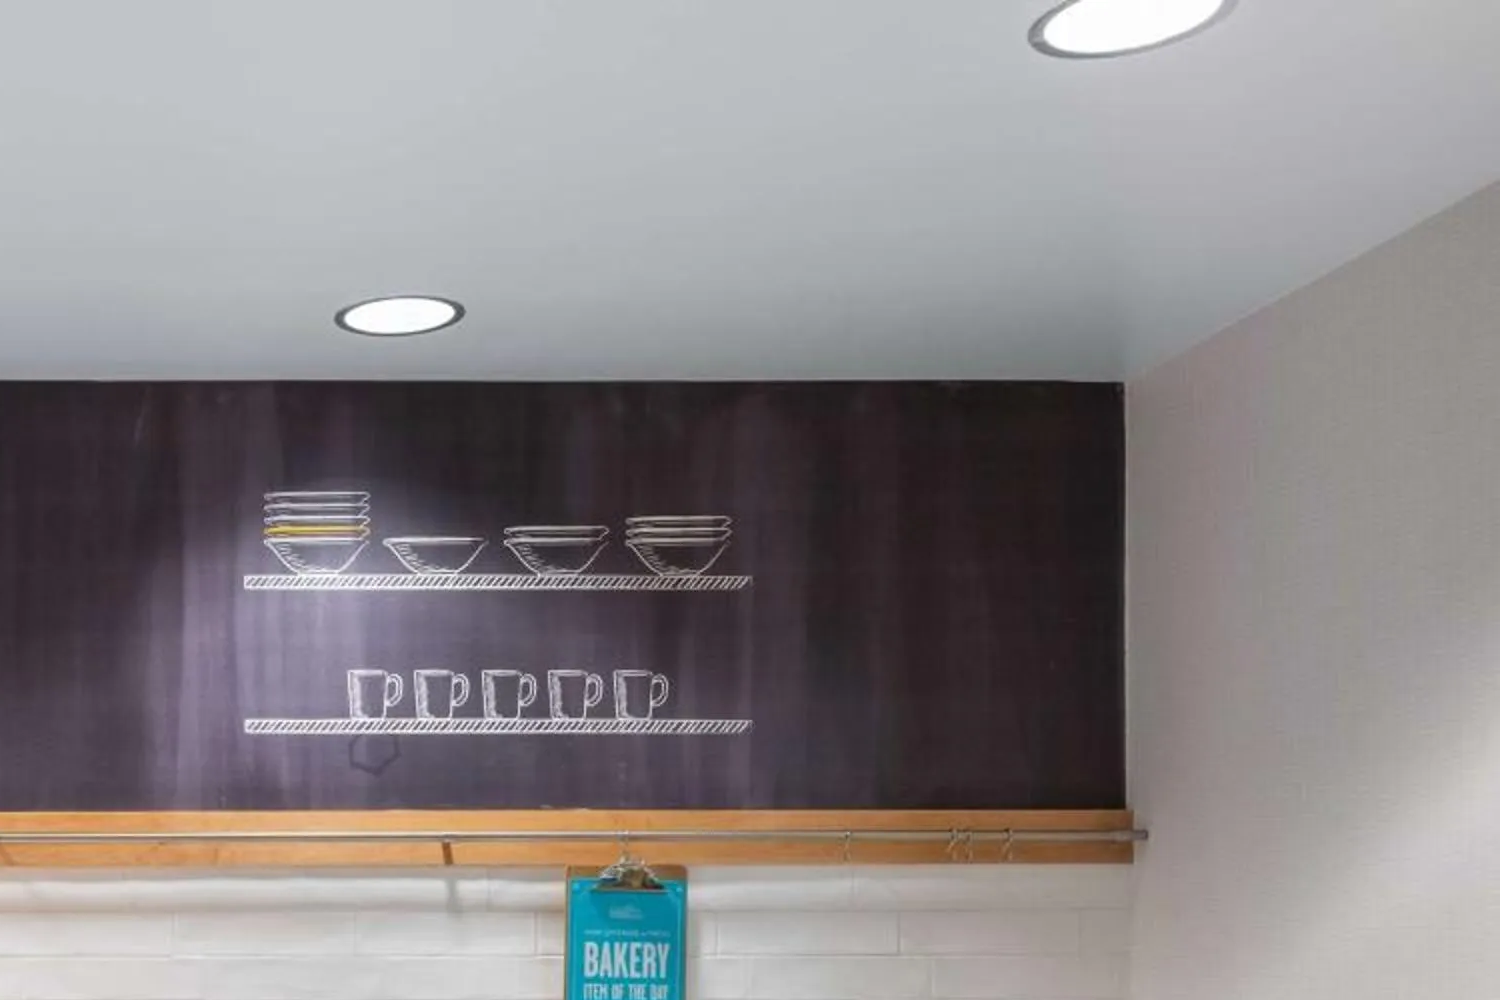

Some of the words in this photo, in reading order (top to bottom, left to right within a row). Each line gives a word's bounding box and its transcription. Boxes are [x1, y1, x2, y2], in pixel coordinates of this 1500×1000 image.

[583, 941, 670, 979] BAKERY
[583, 983, 608, 1000] ITEM
[611, 983, 624, 1000] OF
[628, 983, 647, 1000] THE
[650, 983, 669, 1000] DAY
